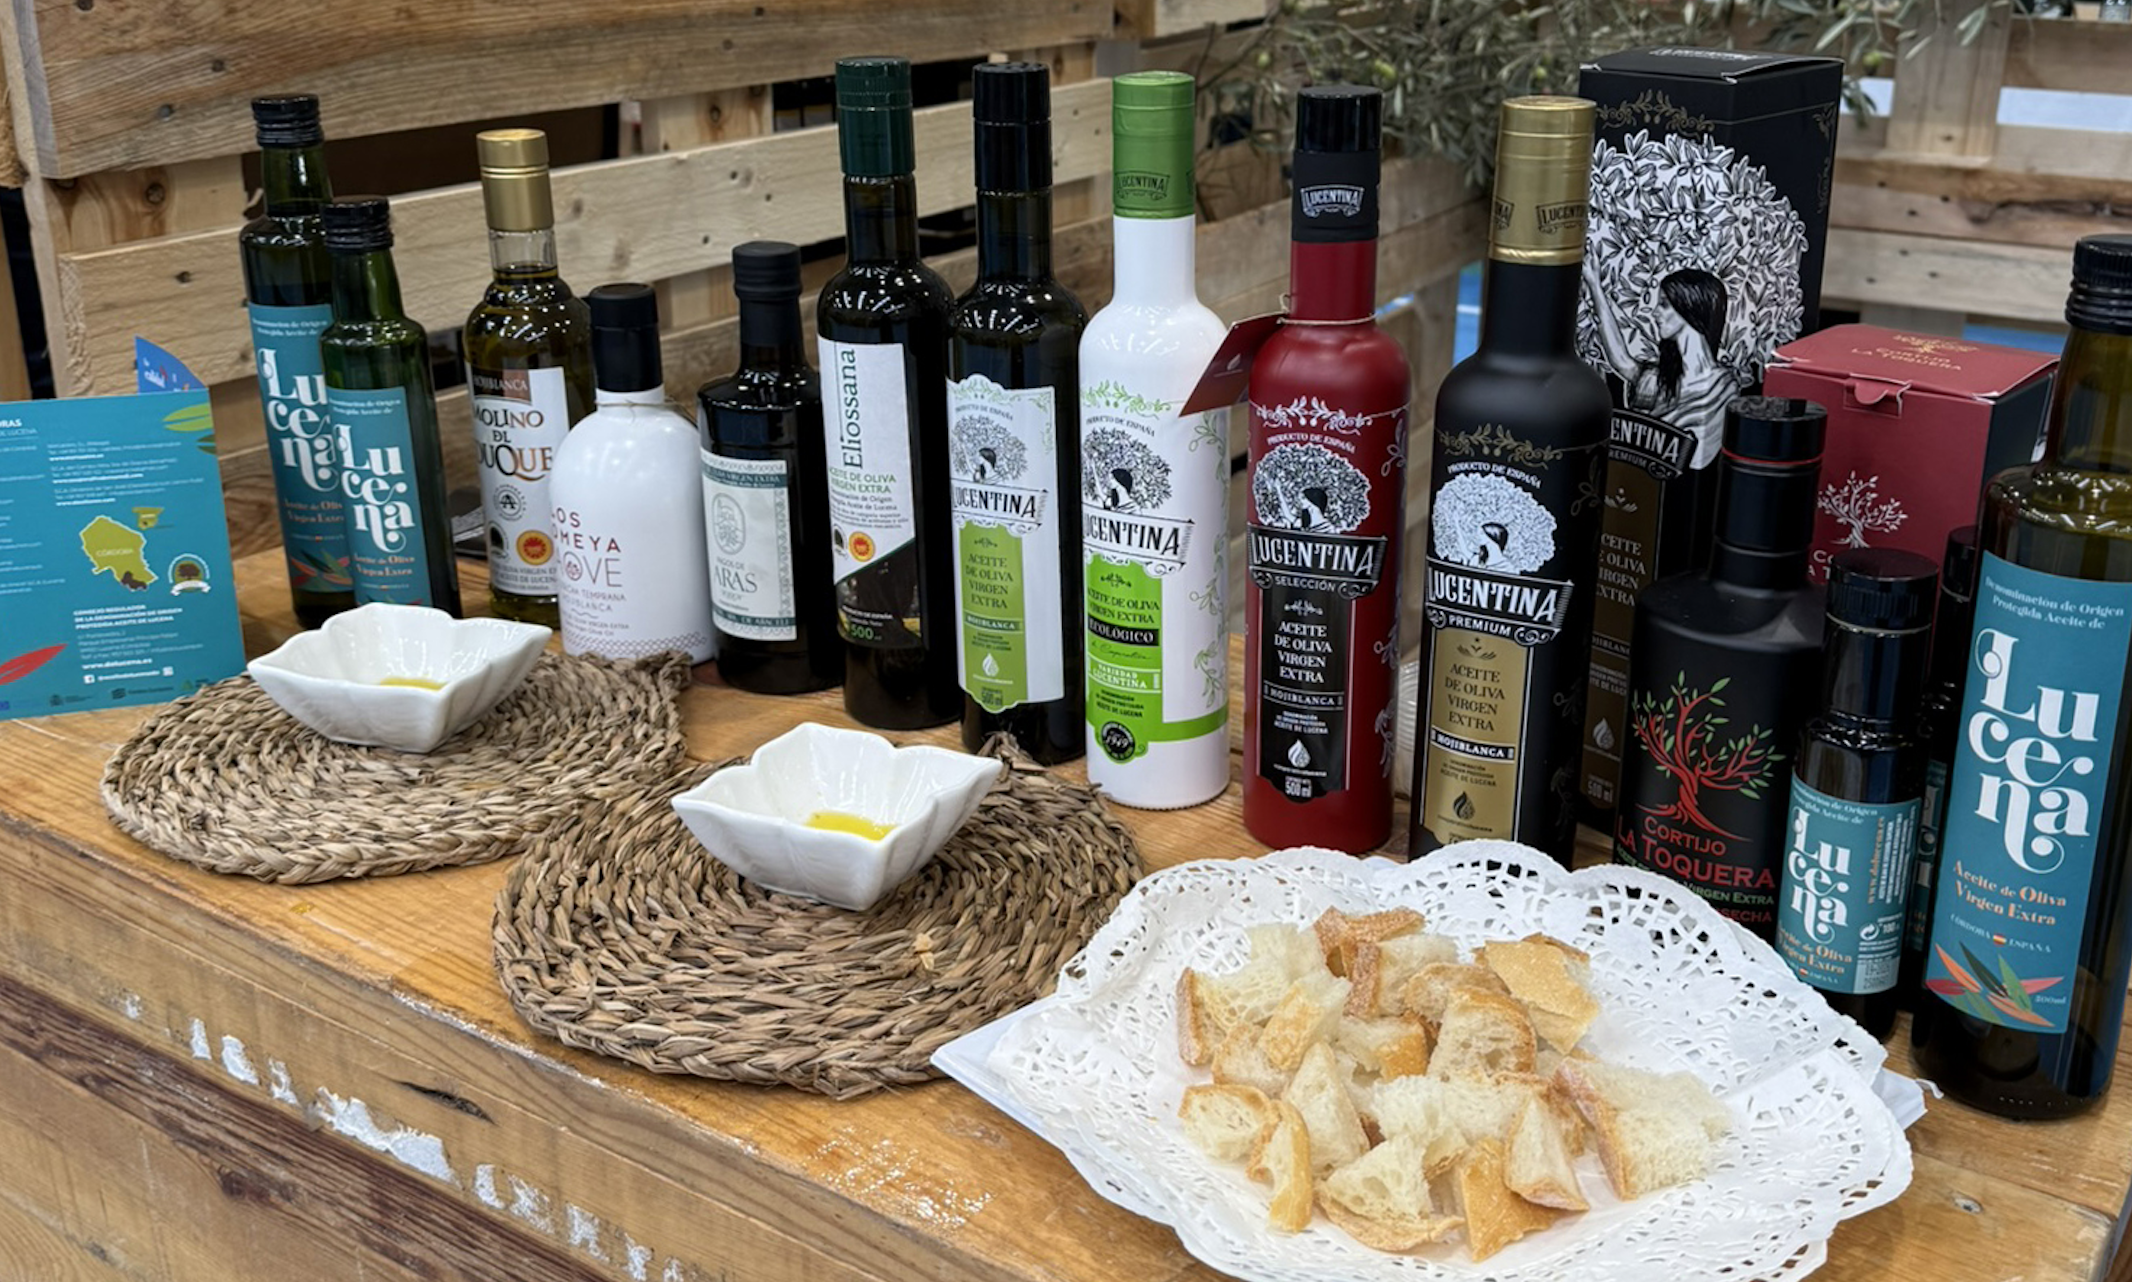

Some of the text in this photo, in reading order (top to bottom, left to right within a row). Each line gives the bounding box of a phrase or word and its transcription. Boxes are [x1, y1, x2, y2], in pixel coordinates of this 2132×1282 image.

[1306, 189, 1358, 207] LUCENTINA
[841, 348, 863, 469] Eliossana
[1126, 420, 1155, 437] ESPAÑA
[1267, 432, 1356, 454] PRODUCTO DE ESPAÑA
[1610, 417, 1680, 464] ENTINA
[1608, 449, 1648, 467] REMIUM
[849, 472, 896, 483] DE OLIVA
[1447, 461, 1541, 489] PRODUCTO DE ESPAÑA
[858, 484, 891, 494] EXTRA
[953, 486, 1036, 518] UCENTINA
[552, 507, 580, 528] OS
[1083, 512, 1180, 556] UCENTINA
[1600, 532, 1642, 556] CEITE
[968, 553, 1007, 568] ACEITE
[1251, 532, 1374, 576] LUCENTINA
[1606, 552, 1646, 575] OLIVA
[714, 565, 758, 594] ARAS
[966, 565, 1013, 582] DE OLIVA
[1598, 567, 1639, 590] IRGEN
[968, 580, 1009, 595] VIRGEN
[1275, 575, 1336, 593] SELECCIÓN
[971, 594, 1008, 609] EXTRA
[1111, 595, 1126, 607] DE
[1126, 597, 1161, 611] OLIVA
[1428, 566, 1558, 623] LUCENTINA
[1985, 576, 2124, 618] Denominación de Origen
[1117, 610, 1155, 624] EXTRA
[1993, 595, 2105, 629] Protegida Aceite de
[851, 624, 874, 640] 500
[1089, 619, 1154, 643] ECOLÓGICO
[1278, 621, 1327, 637] ACEITE
[1449, 616, 1511, 637] PREMIUM
[1274, 634, 1333, 653] DE OLIVA
[1277, 650, 1326, 668] VIRGEN
[1092, 669, 1148, 689] LUCENTINA
[1097, 663, 1138, 679] VARIEDAD
[1279, 666, 1324, 684] EXTRA
[1450, 663, 1500, 683] ACEITE
[1270, 688, 1335, 706] HOJIBLANCA
[1445, 676, 1505, 700] DE OLIVA
[1447, 694, 1498, 715] VIRGEN
[1274, 719, 1328, 735] ACEITE DE LUCENA
[1449, 711, 1494, 732] EXTRA
[1105, 736, 1129, 749] 1949
[1437, 734, 1506, 758] HOJIBLANCA
[1470, 777, 1497, 787] LUCENA
[1822, 808, 1864, 824] Aceite de
[1844, 805, 1878, 817] Origen
[1644, 815, 1727, 857] CORTIJO
[1617, 814, 1776, 889] LA TOQUERA
[1955, 860, 2066, 907] Aceite de Oliva
[1733, 892, 1775, 906] EXTRA
[1955, 880, 2056, 925] Virgen Extra
[1717, 908, 1772, 923] SECHA
[1807, 953, 1845, 974] Extra
[1816, 945, 1852, 963] Oliva
